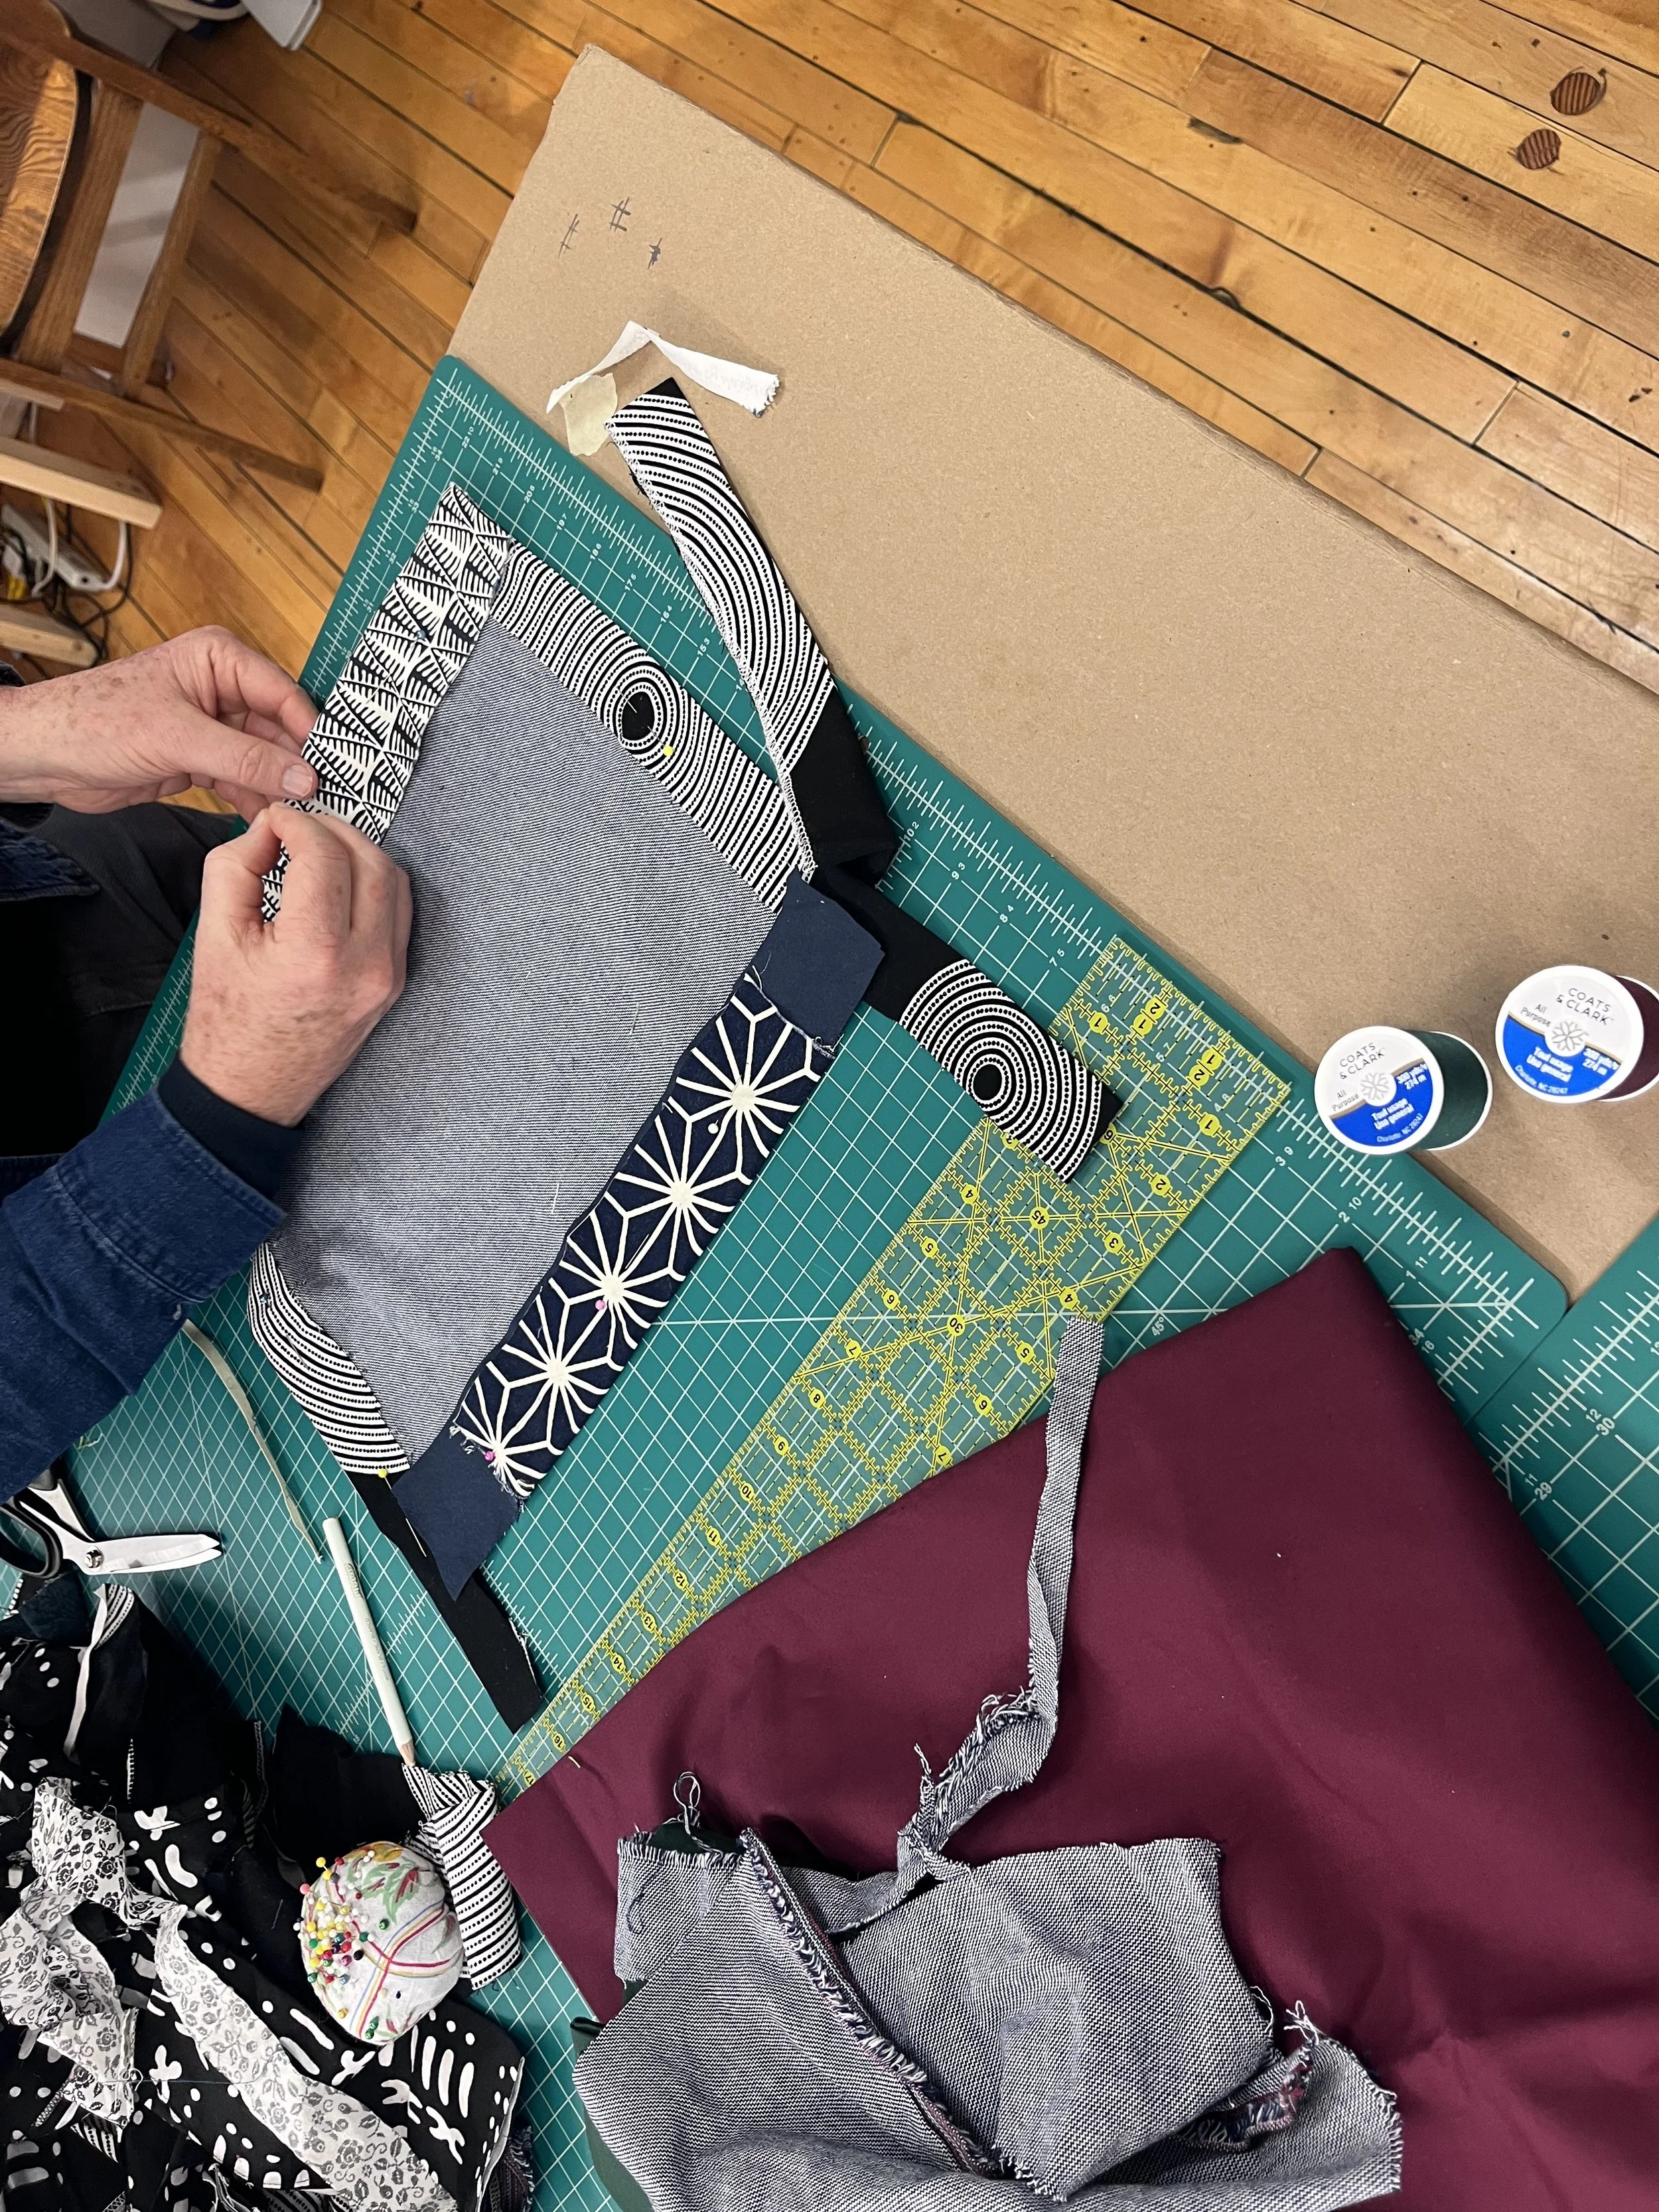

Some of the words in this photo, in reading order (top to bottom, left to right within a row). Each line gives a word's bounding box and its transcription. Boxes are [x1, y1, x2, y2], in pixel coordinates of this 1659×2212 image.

[493, 463, 501, 475] 21
[524, 490, 533, 503] 20
[557, 519, 565, 530] 19
[625, 579, 634, 590] 17
[661, 611, 670, 623] 16
[697, 645, 707, 656] 15
[904, 828, 915, 841] 10
[912, 821, 920, 830] 2
[951, 871, 960, 880] 9
[999, 913, 1008, 923] 8
[1048, 956, 1058, 966] 7
[1056, 948, 1065, 956] 5
[1568, 988, 1611, 1012] COATS
[1101, 1003, 1110, 1013] 6
[1150, 1003, 1161, 1015] 2
[1534, 1003, 1547, 1013] All
[1556, 994, 1564, 1003] &
[1567, 999, 1607, 1025] CLARK
[1520, 1007, 1551, 1027] Purpose
[1155, 1052, 1165, 1062] 5
[1339, 1042, 1376, 1067] COATS
[1348, 1047, 1386, 1074] CLARK
[1194, 1069, 1205, 1080] 2
[1336, 1089, 1346, 1099] All
[1214, 1103, 1222, 1112] 4
[1332, 1094, 1359, 1112] Purpose
[1371, 1108, 1388, 1121] Tout
[1388, 1103, 1415, 1124] general
[1275, 1155, 1286, 1166] 3
[1283, 1146, 1293, 1155] 9
[1338, 1211, 1350, 1224] 2
[1348, 1197, 1362, 1210] 10
[1031, 1210, 1046, 1225] 45
[1406, 1270, 1417, 1280] 1
[1415, 1256, 1428, 1268] 11
[949, 1317, 963, 1333] 30
[1408, 1328, 1425, 1345] 34
[1421, 1340, 1435, 1353] 16
[1585, 1408, 1602, 1423] 12
[1596, 1417, 1615, 1437] 30
[742, 1485, 752, 1498] 10
[1524, 1473, 1538, 1486] 11
[1534, 1482, 1553, 1501] 29
[709, 1530, 717, 1542] 11
[676, 1575, 685, 1587] 12
[644, 1616, 654, 1628] 13
[613, 1657, 622, 1669] 14
[583, 1697, 592, 1709] 15
[554, 1735, 563, 1747] 16
